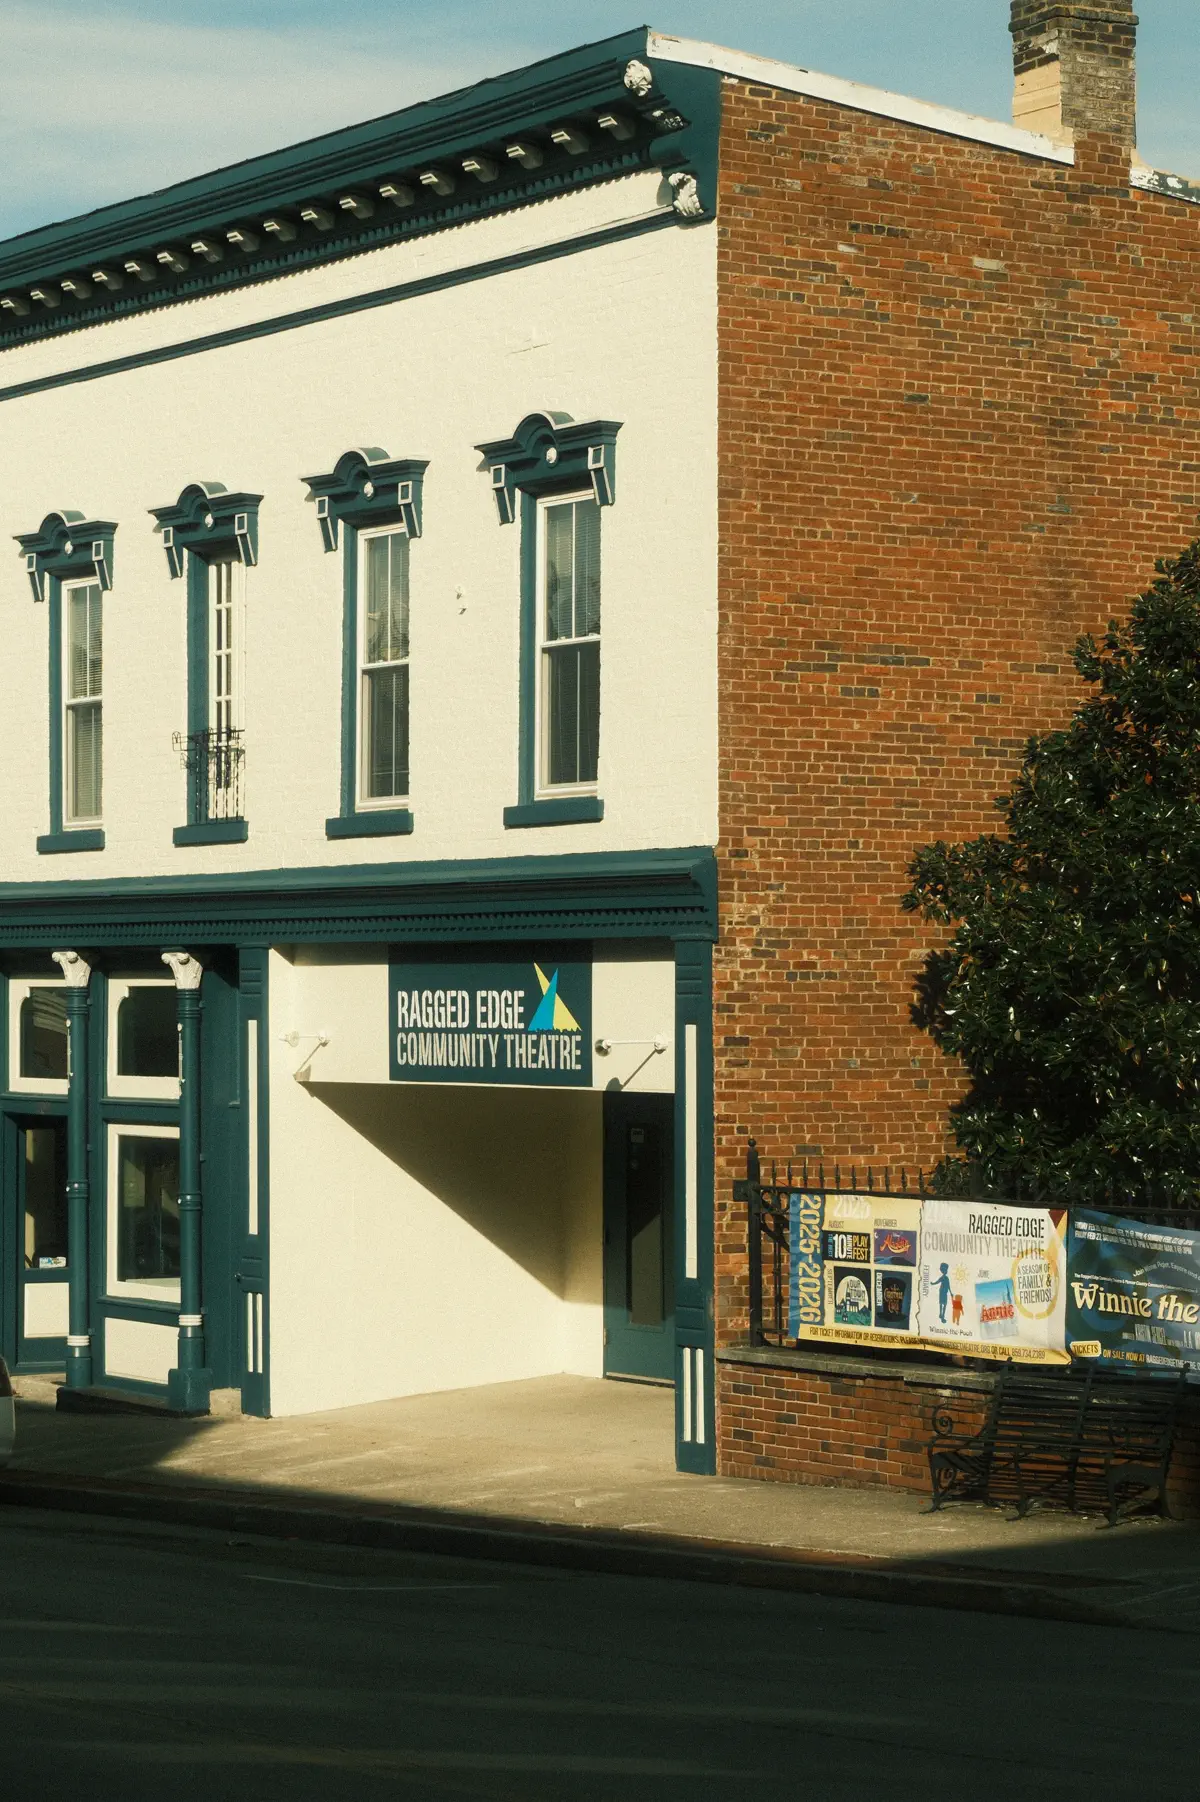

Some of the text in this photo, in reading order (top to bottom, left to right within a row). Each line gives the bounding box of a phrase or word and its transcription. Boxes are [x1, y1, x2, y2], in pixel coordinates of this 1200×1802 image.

[397, 989, 525, 1030] RAGGED EDGE
[396, 1032, 582, 1070] COMMUNITY THEATRE
[828, 1220, 844, 1228] AUGUST
[874, 1219, 897, 1227] NOVEMBER
[968, 1213, 1045, 1239] RAGGED EDGE
[833, 1234, 846, 1259] 10
[852, 1235, 868, 1248] PLAY
[924, 1231, 1045, 1260] COMMUNITY THEATRE
[800, 1194, 822, 1323] 2025-2026
[852, 1248, 868, 1260] FEST
[1022, 1265, 1042, 1274] SEASON
[1043, 1263, 1050, 1273] OF
[849, 1279, 861, 1289] OUR
[1017, 1274, 1052, 1289] FAMILY &
[1019, 1288, 1052, 1304] FRIENDS!
[1071, 1282, 1200, 1324] Winnie the
[980, 1302, 1014, 1323] Annie
[809, 1326, 818, 1335] FOR
[819, 1328, 833, 1337] TICKET
[834, 1329, 862, 1340] INFORMATION
[863, 1332, 869, 1341] OR
[900, 1335, 918, 1345] PLEASE
[991, 1346, 997, 1355] OR
[998, 1346, 1010, 1356] CALL
[1072, 1342, 1099, 1355] TICKETS
[1103, 1350, 1111, 1358] ON
[1111, 1351, 1125, 1360] SALE
[1126, 1351, 1138, 1362] NOW
[1138, 1353, 1145, 1362] AT
